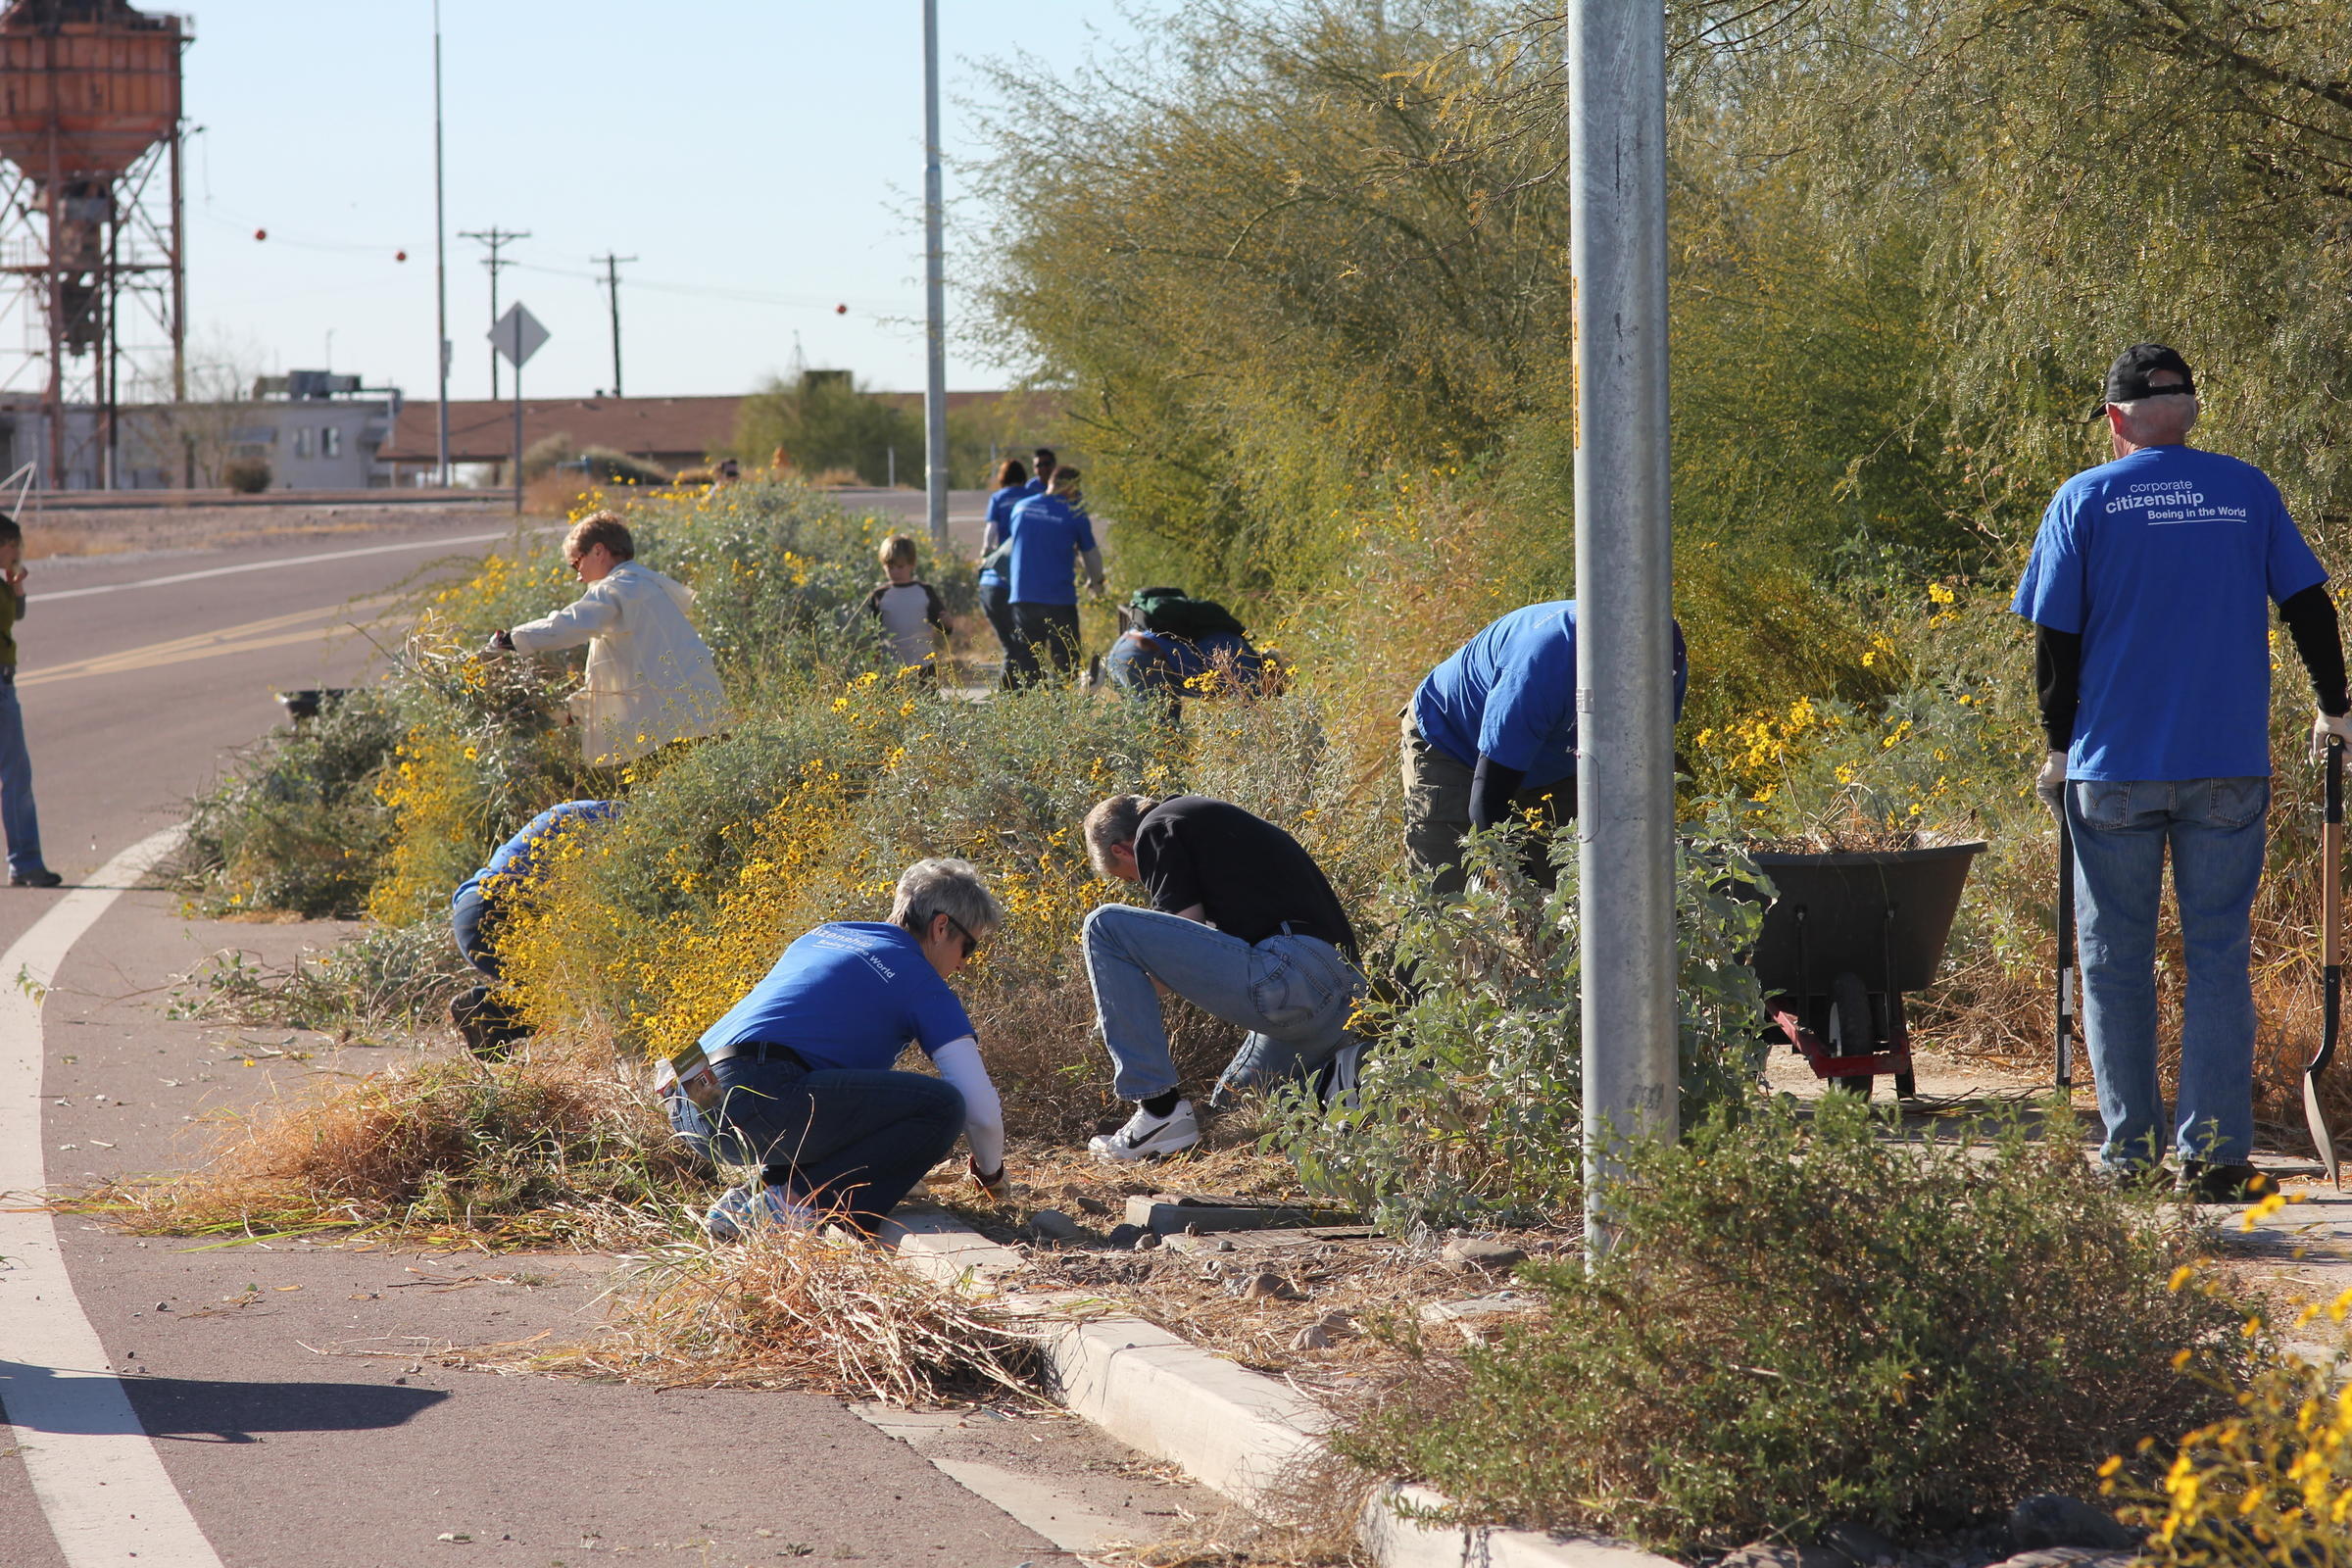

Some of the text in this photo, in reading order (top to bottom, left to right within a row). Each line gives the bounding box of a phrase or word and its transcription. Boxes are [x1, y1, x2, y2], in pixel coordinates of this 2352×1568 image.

[2130, 479, 2193, 493] corporate
[2105, 490, 2204, 514] citizenship
[2147, 506, 2246, 519] Boeing in the World
[855, 946, 869, 956] the
[869, 955, 896, 979] World
